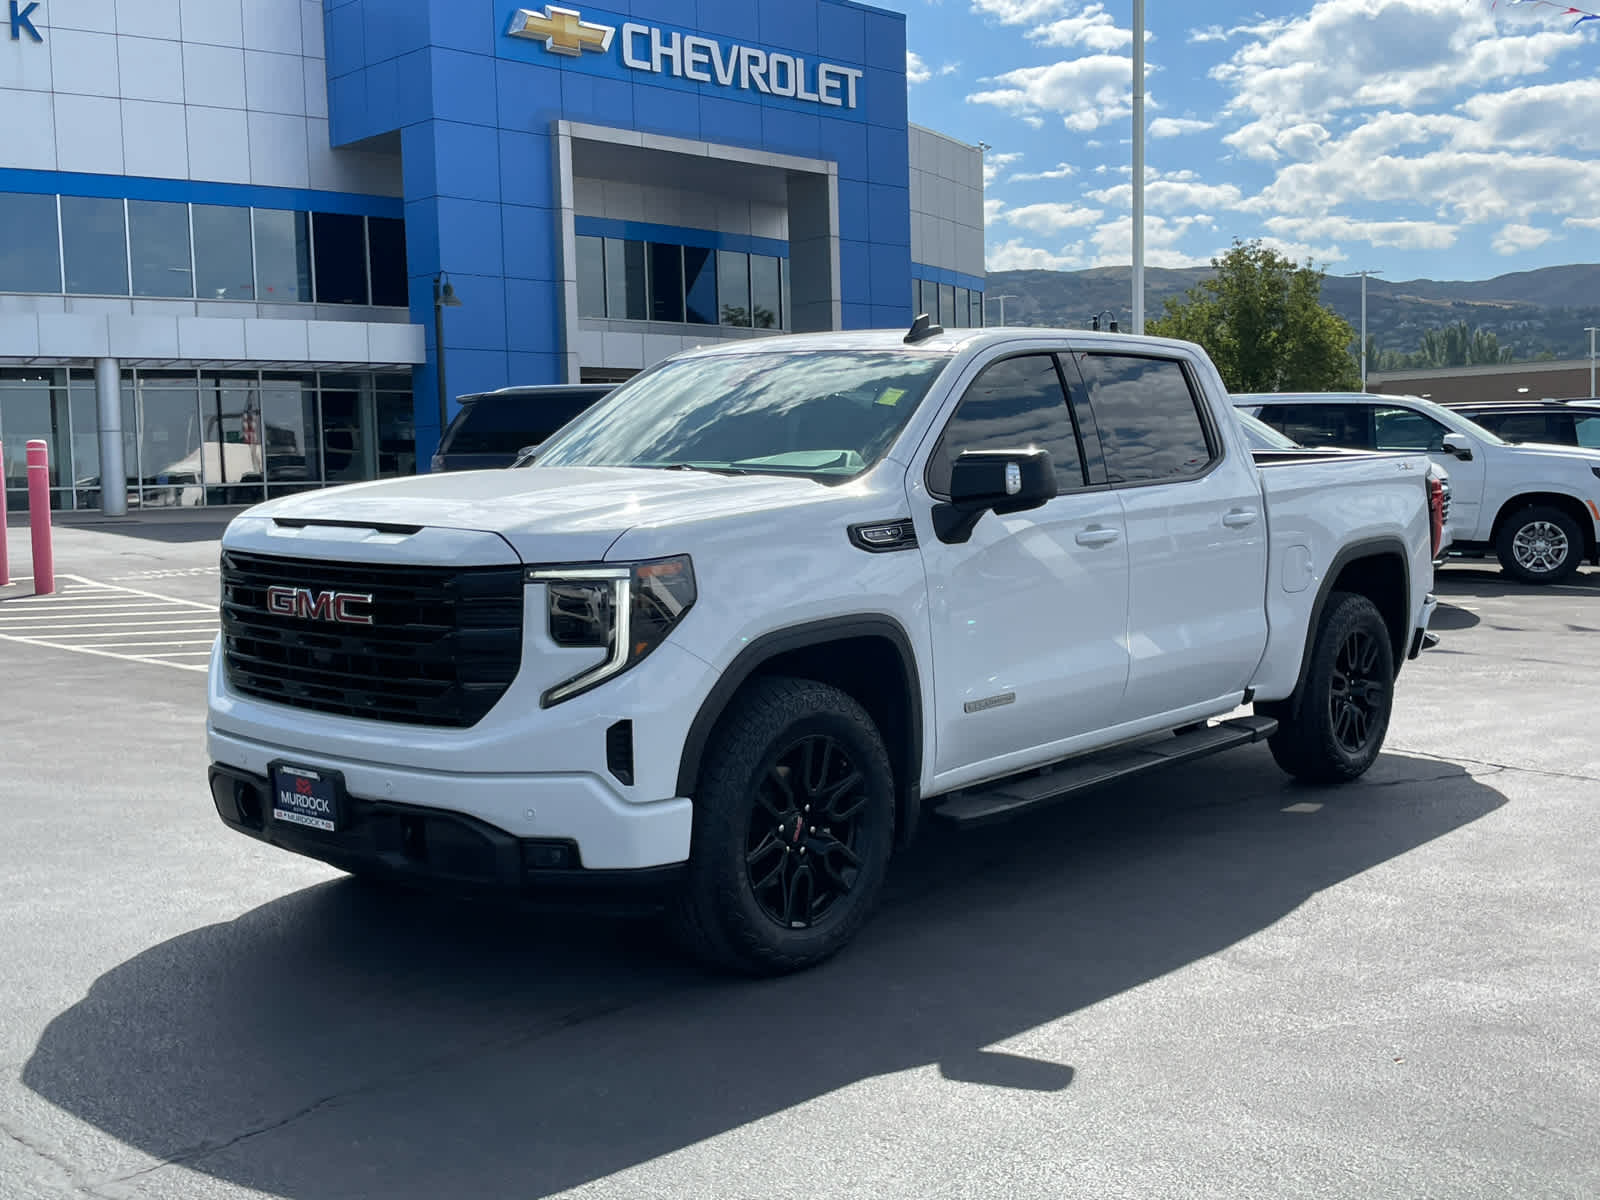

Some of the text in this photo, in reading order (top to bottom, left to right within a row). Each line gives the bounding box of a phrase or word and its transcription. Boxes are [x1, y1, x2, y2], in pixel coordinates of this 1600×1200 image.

[9, 0, 44, 43] K
[622, 22, 863, 109] CHEVROLET
[267, 585, 373, 625] GMC
[280, 790, 330, 814] MURDOCK
